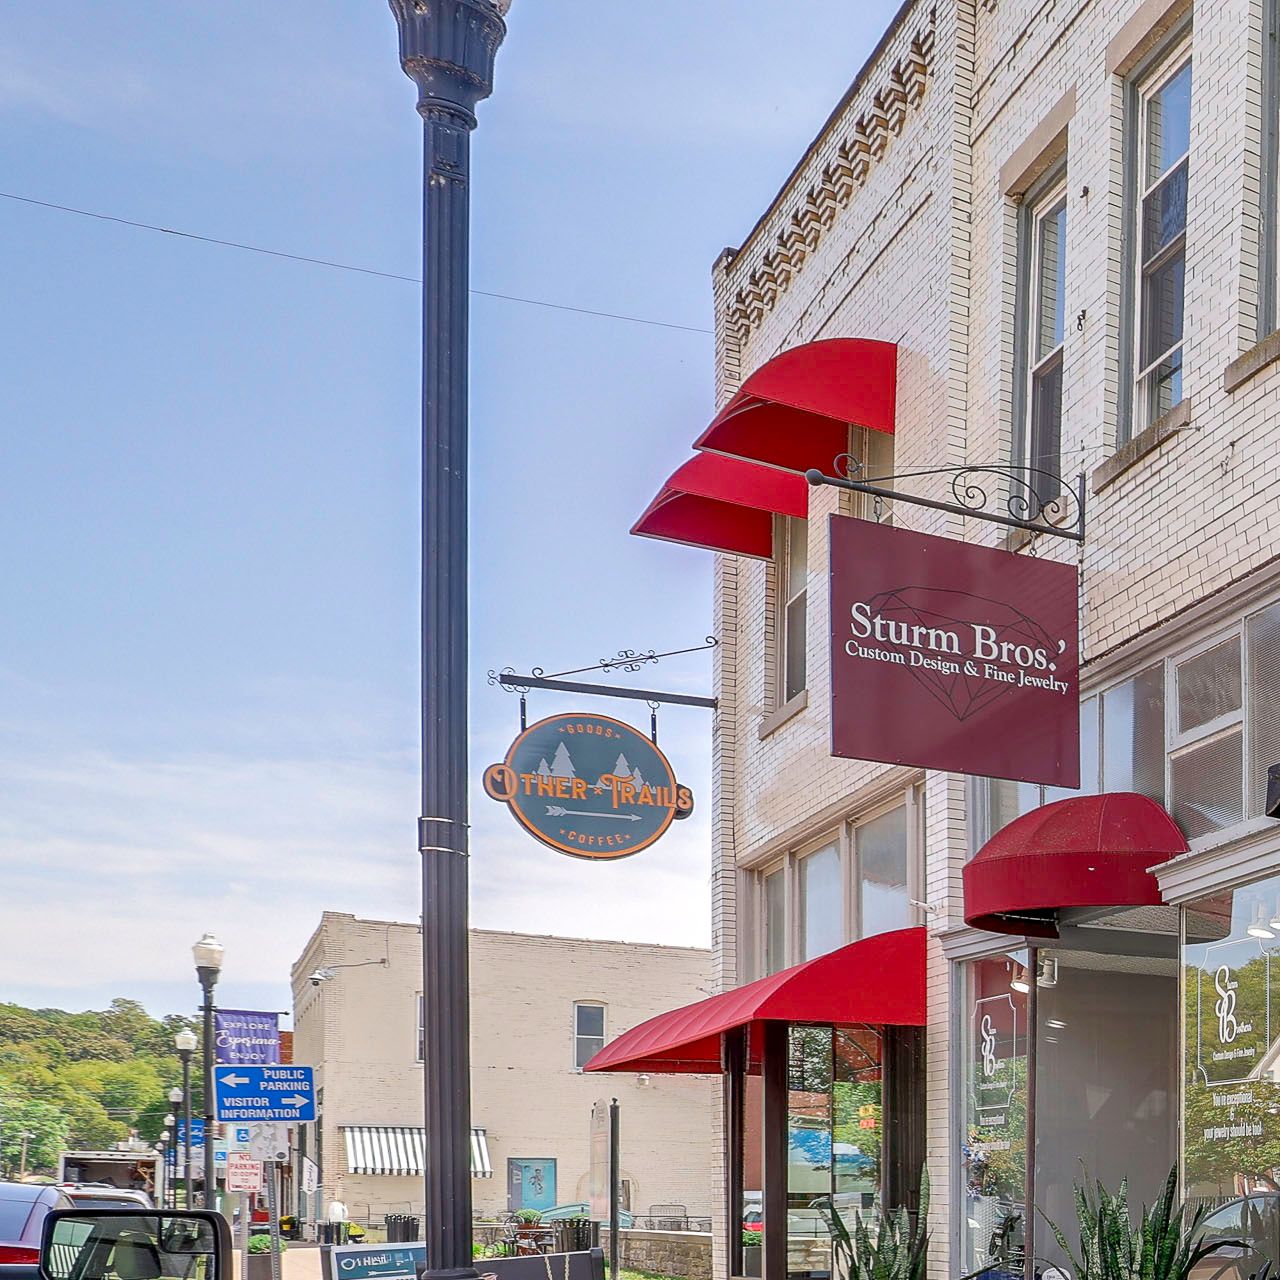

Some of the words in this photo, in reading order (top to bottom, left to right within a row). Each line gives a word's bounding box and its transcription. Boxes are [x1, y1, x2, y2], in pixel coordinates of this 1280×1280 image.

[850, 601, 962, 655] Sturm
[844, 639, 906, 665] Custom
[908, 650, 961, 675] Design
[963, 660, 981, 677] &
[983, 662, 1016, 684] Fine
[1017, 669, 1069, 695] Jewelry
[567, 723, 613, 739] GOODS
[483, 763, 588, 801] OTHER
[600, 773, 693, 811] TRAILS
[567, 830, 625, 847] COFFEE
[223, 1021, 271, 1030] EXPLORE
[229, 1052, 268, 1060] ENJOY
[263, 1069, 305, 1080] PUBLIC
[259, 1081, 310, 1091] PARKING
[223, 1097, 270, 1107] VISITOR
[220, 1108, 301, 1119] INFORMATION
[239, 1154, 250, 1162] NO
[229, 1162, 260, 1171] PARKING
